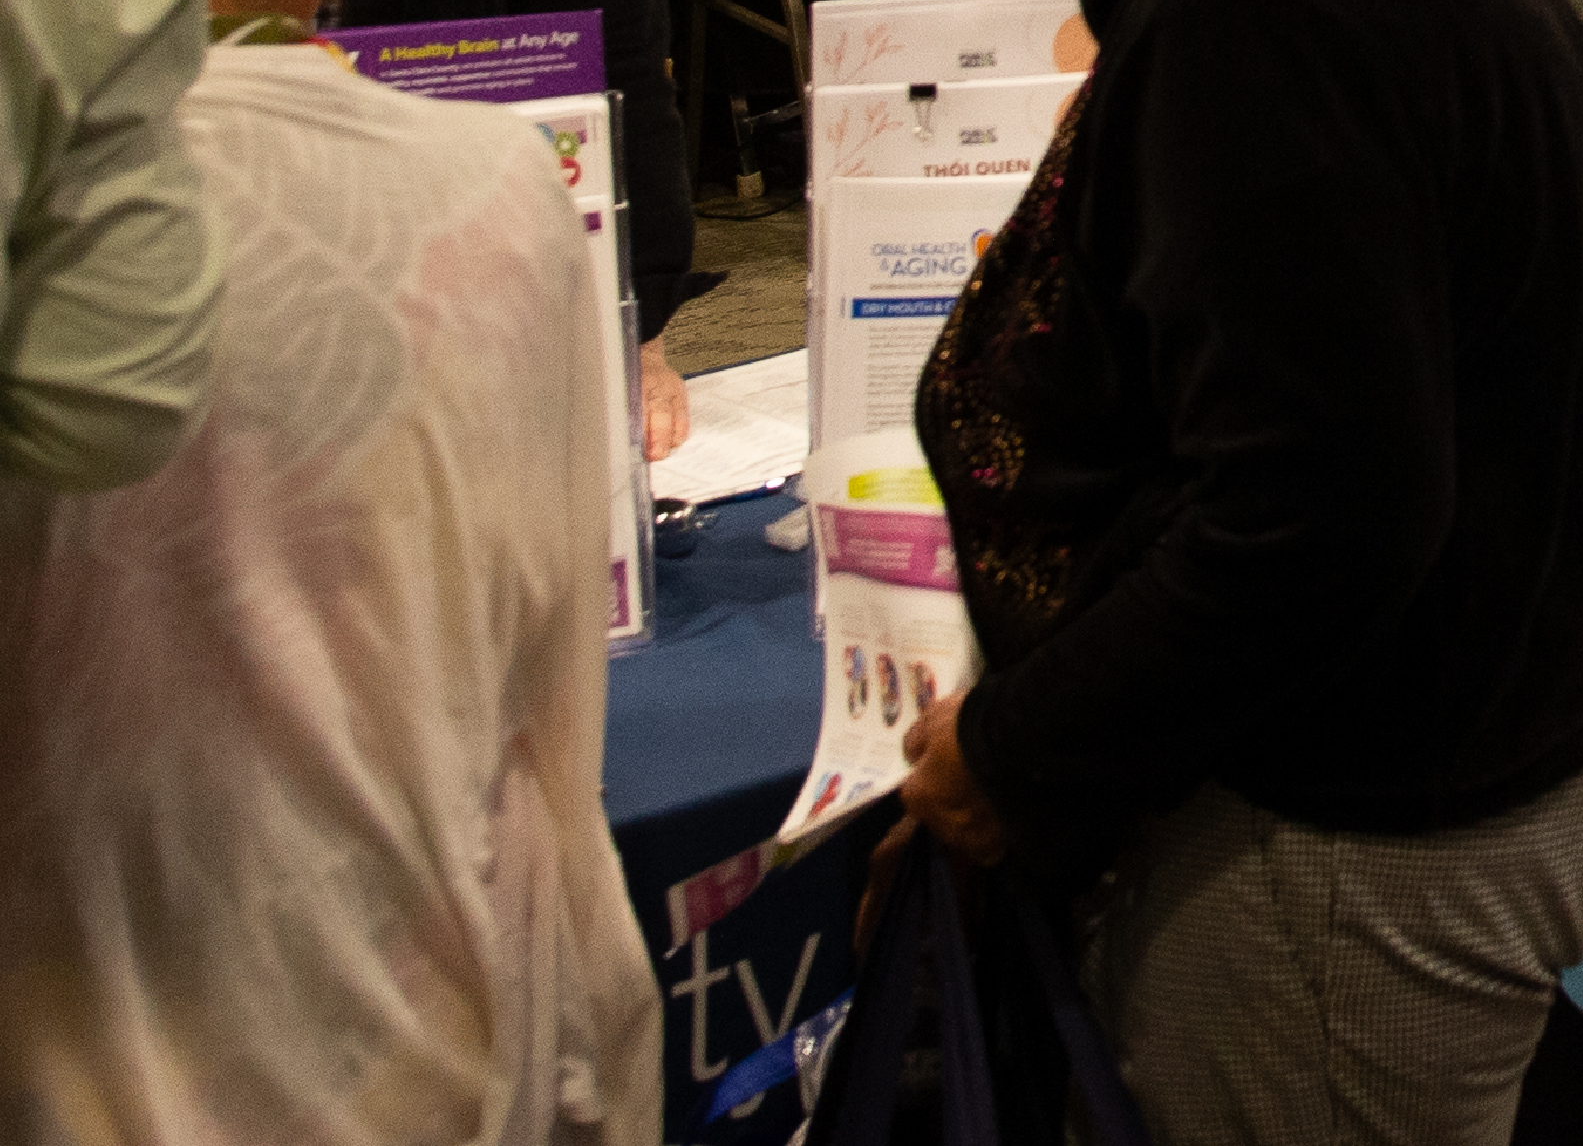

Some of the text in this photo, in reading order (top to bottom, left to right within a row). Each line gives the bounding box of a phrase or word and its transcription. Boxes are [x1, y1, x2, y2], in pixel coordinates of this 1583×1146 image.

[379, 47, 392, 62] A
[396, 42, 455, 61] Healthy
[458, 38, 500, 54] Brain
[520, 33, 548, 49] Any
[550, 31, 580, 48] Age
[870, 242, 966, 256] ORAL HEALTH
[890, 257, 967, 277] AGING
